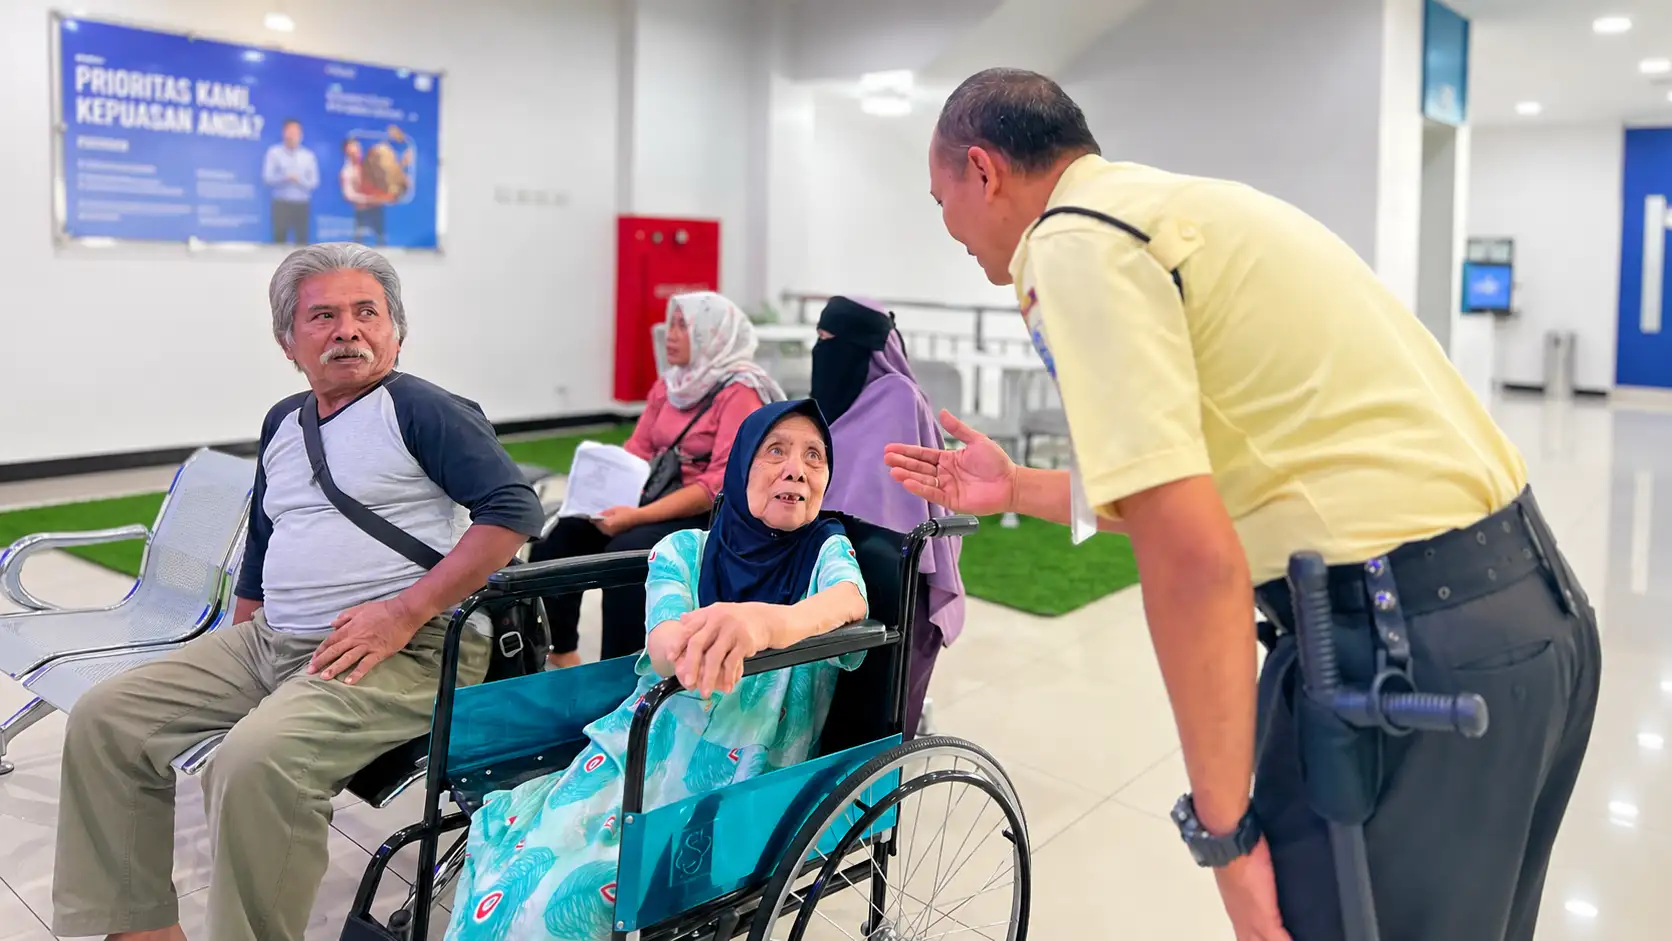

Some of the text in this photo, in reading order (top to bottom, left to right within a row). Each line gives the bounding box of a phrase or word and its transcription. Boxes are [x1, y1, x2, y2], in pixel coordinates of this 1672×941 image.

[75, 65, 192, 104] PRIORITAS
[75, 96, 265, 140] KEPUASAN ANDA?
